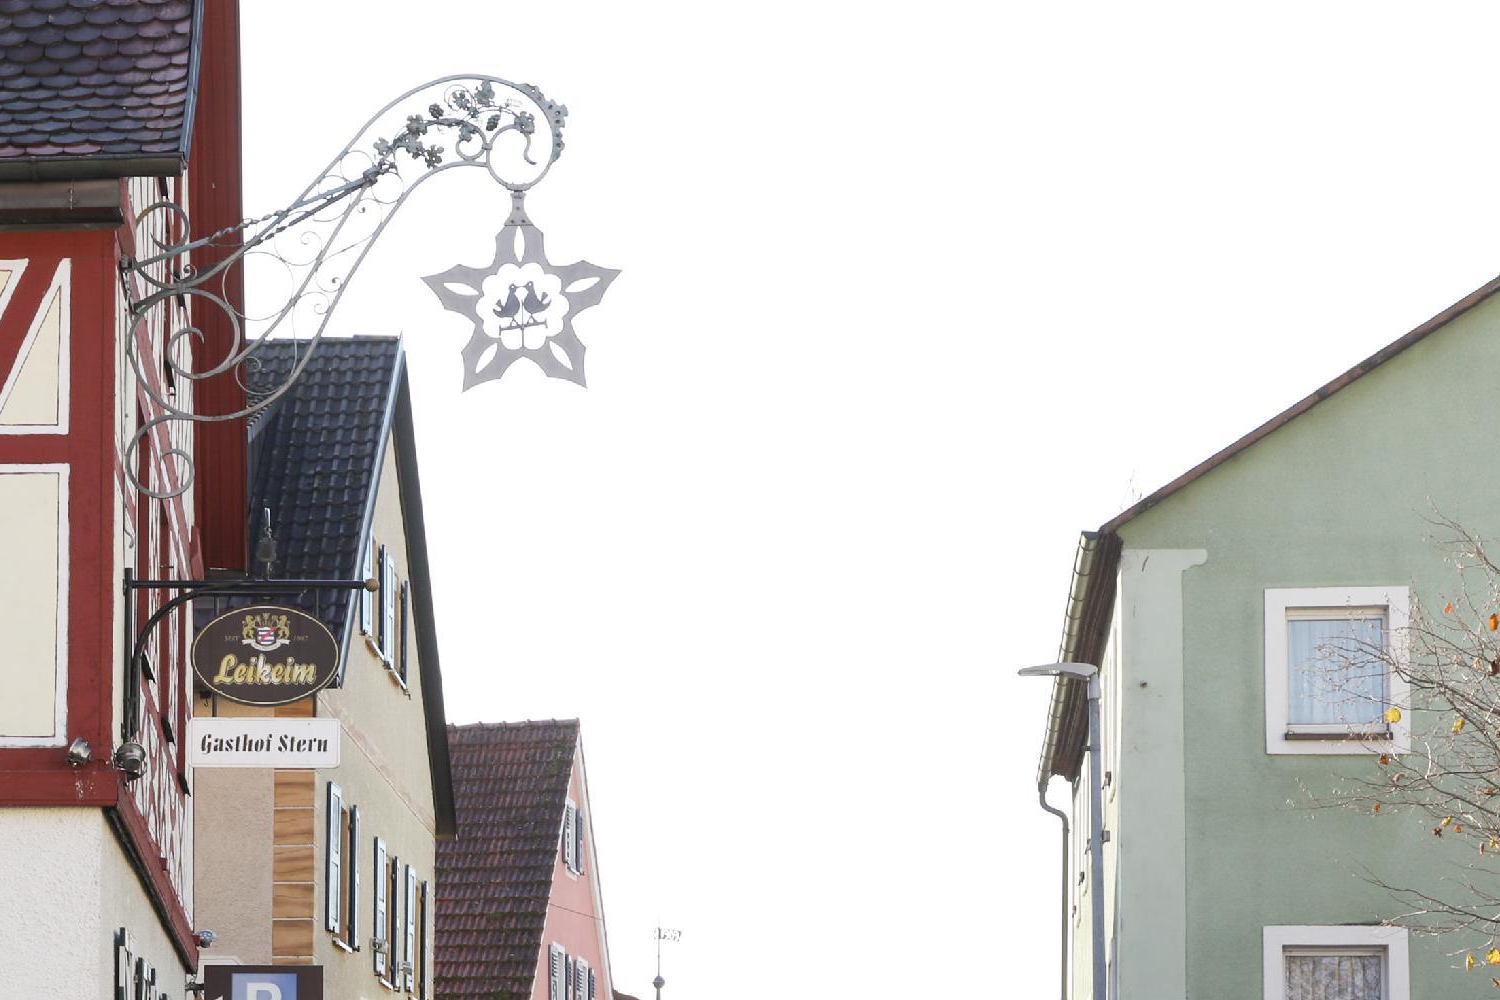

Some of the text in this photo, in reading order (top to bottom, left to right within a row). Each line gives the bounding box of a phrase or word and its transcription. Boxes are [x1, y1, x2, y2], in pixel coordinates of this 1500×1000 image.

[213, 653, 317, 685] Leikeim
[201, 733, 328, 755] Gasthof Stern
